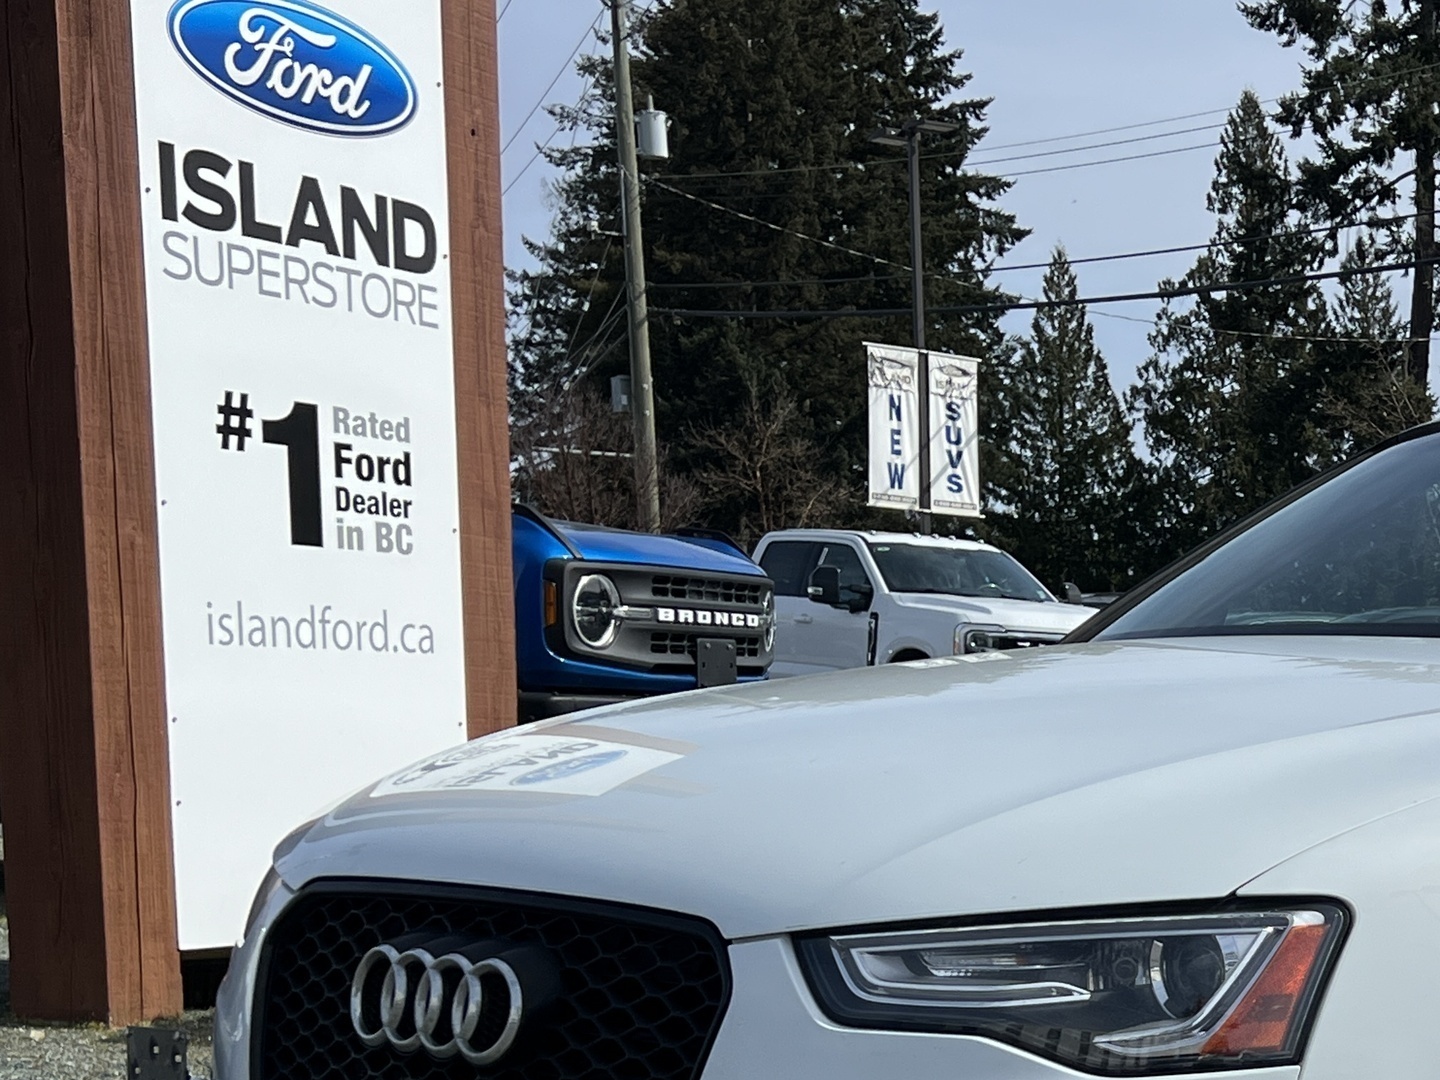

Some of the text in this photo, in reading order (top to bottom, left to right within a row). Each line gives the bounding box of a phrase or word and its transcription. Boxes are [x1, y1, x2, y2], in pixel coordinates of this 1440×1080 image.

[223, 6, 374, 119] Ford
[157, 139, 438, 275] ISLAND
[161, 230, 440, 330] SUPERSTORE
[332, 406, 411, 444] Rated
[886, 392, 906, 491] NEW
[215, 390, 324, 548] #1
[334, 443, 412, 487] Ford
[335, 485, 413, 520] Dealer
[336, 519, 414, 556] in BC
[206, 600, 435, 655] islandford.ca
[656, 606, 760, 628] BRONCO
